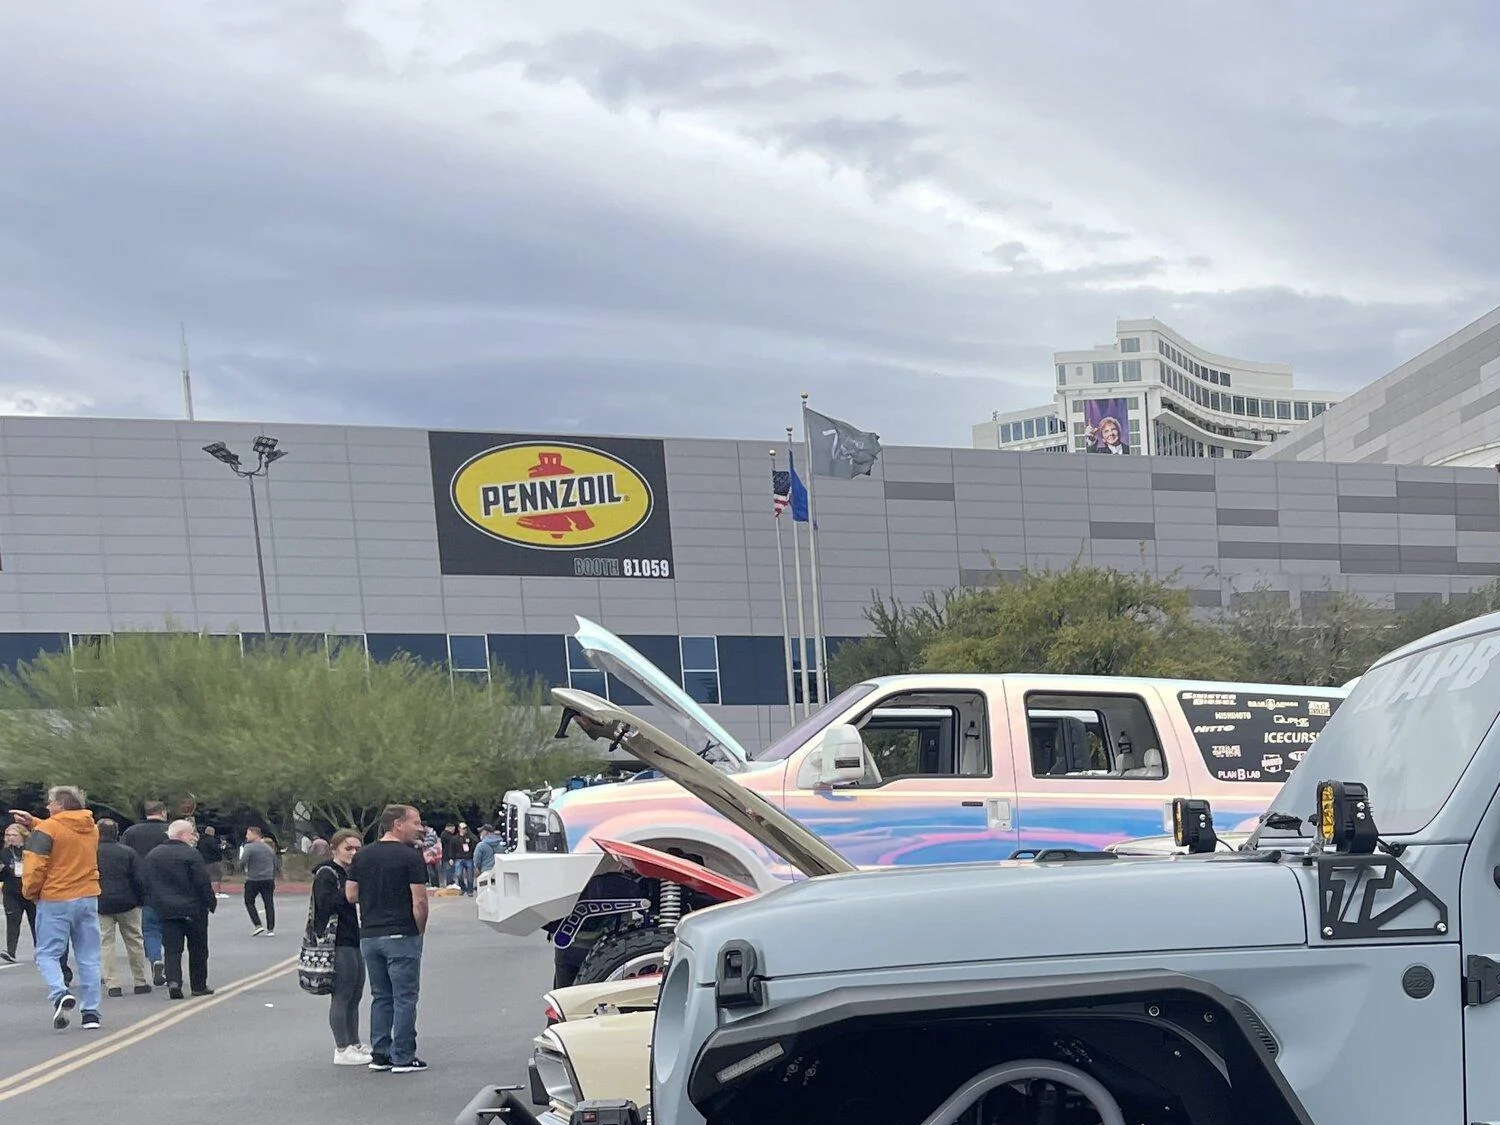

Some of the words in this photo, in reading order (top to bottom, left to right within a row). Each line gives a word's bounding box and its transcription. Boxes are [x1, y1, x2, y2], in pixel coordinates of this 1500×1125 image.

[481, 473, 623, 517] PENNZOIL
[574, 557, 620, 577] BOOTH
[622, 558, 670, 578] 81059
[1193, 725, 1236, 734] NITTO
[1217, 770, 1237, 779] PLAN
[1237, 768, 1246, 780] B
[1246, 770, 1261, 779] LAB
